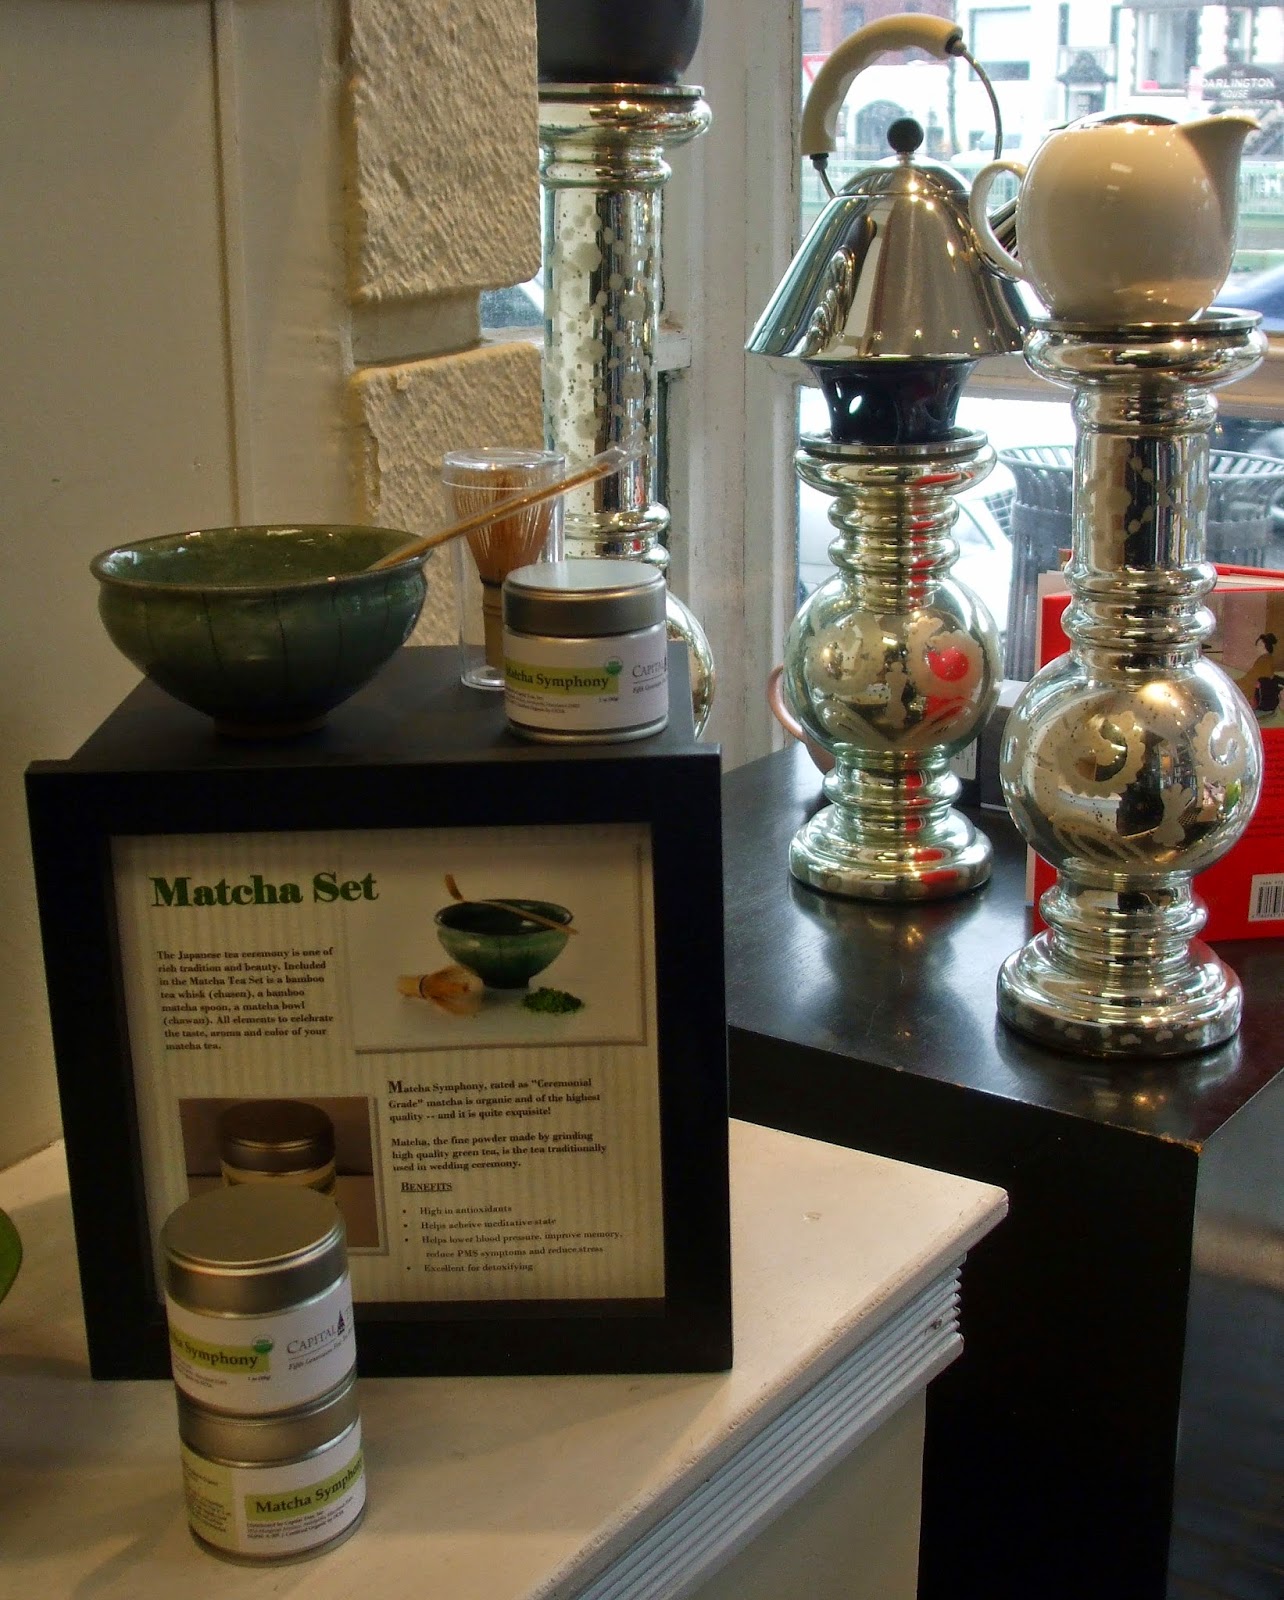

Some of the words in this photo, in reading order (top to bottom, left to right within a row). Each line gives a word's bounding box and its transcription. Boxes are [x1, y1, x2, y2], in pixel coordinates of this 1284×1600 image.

[1202, 78, 1274, 88] DARLINGTON
[1221, 90, 1249, 98] HOUSE
[537, 673, 609, 690] Symphony
[150, 874, 303, 907] Matcha
[313, 871, 379, 903] Set
[157, 951, 175, 960] The
[178, 951, 222, 961] Japanese
[242, 950, 289, 960] ceremony
[323, 947, 333, 955] of
[158, 964, 177, 973] rich
[180, 964, 221, 972] tradition
[224, 963, 242, 972] and
[244, 963, 281, 973] beauty.
[284, 961, 326, 970] Included
[160, 977, 169, 985] in
[172, 977, 187, 985] the
[190, 976, 225, 985] Matcha
[228, 976, 246, 984] Tea
[249, 975, 264, 984] Set
[266, 976, 274, 984] is
[286, 975, 324, 983] bamboo
[161, 991, 175, 999] tea
[178, 990, 205, 998] whisk
[209, 990, 255, 999] (chasen),
[266, 988, 305, 997] bamboo
[162, 1003, 197, 1012] matcha
[200, 1003, 231, 1013] spoon,
[243, 1002, 279, 1010] matcha
[282, 1001, 305, 1010] bowl
[164, 1016, 213, 1026] (chawan).
[216, 1015, 230, 1024] All
[233, 1015, 276, 1023] elements
[278, 1015, 288, 1023] to
[290, 1014, 333, 1023] celebrate
[165, 1029, 180, 1037] the
[182, 1029, 208, 1038] taste,
[244, 1028, 261, 1036] and
[264, 1027, 288, 1036] color
[292, 1027, 302, 1035] of
[304, 1028, 326, 1038] your
[166, 1042, 202, 1050] matcha
[388, 1080, 431, 1094] Matcha
[433, 1081, 487, 1092] Symphony,
[490, 1080, 515, 1089] rated
[531, 1078, 591, 1088] "Ceremonial
[388, 1098, 423, 1109] Grade"
[426, 1098, 463, 1107] matcha
[466, 1097, 473, 1105] is
[476, 1096, 512, 1106] organic
[515, 1095, 532, 1103] and
[535, 1093, 546, 1102] of
[548, 1094, 563, 1102] the
[566, 1093, 600, 1103] highest
[389, 1112, 422, 1122] quality
[437, 1111, 455, 1120] and
[458, 1110, 465, 1118] it
[468, 1110, 476, 1118] is
[479, 1109, 503, 1119] quite
[505, 1107, 551, 1118] exquisite!
[391, 1138, 430, 1147] Matcha,
[433, 1136, 448, 1145] the
[451, 1136, 470, 1144] fine
[472, 1135, 507, 1146] powder
[509, 1133, 535, 1142] made
[538, 1132, 549, 1143] by
[552, 1132, 593, 1143] grinding
[392, 1151, 413, 1161] high
[416, 1149, 449, 1160] quality
[452, 1150, 479, 1160] green
[482, 1149, 499, 1157] tea,
[513, 1146, 528, 1154] the
[548, 1143, 606, 1154] traditionally
[393, 1163, 414, 1172] used
[417, 1163, 427, 1171] in
[429, 1161, 469, 1171] wedding
[472, 1160, 521, 1170] ceremony.
[401, 1181, 452, 1193] BENEFITS
[420, 1206, 443, 1217] High
[445, 1206, 453, 1214] in
[455, 1205, 512, 1214] antioxidants
[421, 1221, 446, 1231] Helps
[449, 1220, 481, 1229] acheive
[484, 1218, 532, 1227] meditative
[534, 1217, 556, 1225] state
[422, 1235, 447, 1246] Helps
[450, 1235, 473, 1243] lower
[475, 1233, 500, 1242] blood
[545, 1231, 581, 1241] improve
[426, 1249, 455, 1258] reduce
[457, 1249, 478, 1257] PMS
[481, 1248, 527, 1258] symptoms
[529, 1247, 545, 1255] and
[548, 1246, 577, 1254] reduce
[578, 1245, 603, 1253] stress
[424, 1263, 464, 1272] Excellent
[467, 1262, 480, 1271] for
[482, 1261, 533, 1272] detoxifying
[287, 1326, 337, 1354] CAPITAL
[185, 1342, 258, 1369] Symphony
[256, 1495, 312, 1512] Matcha
